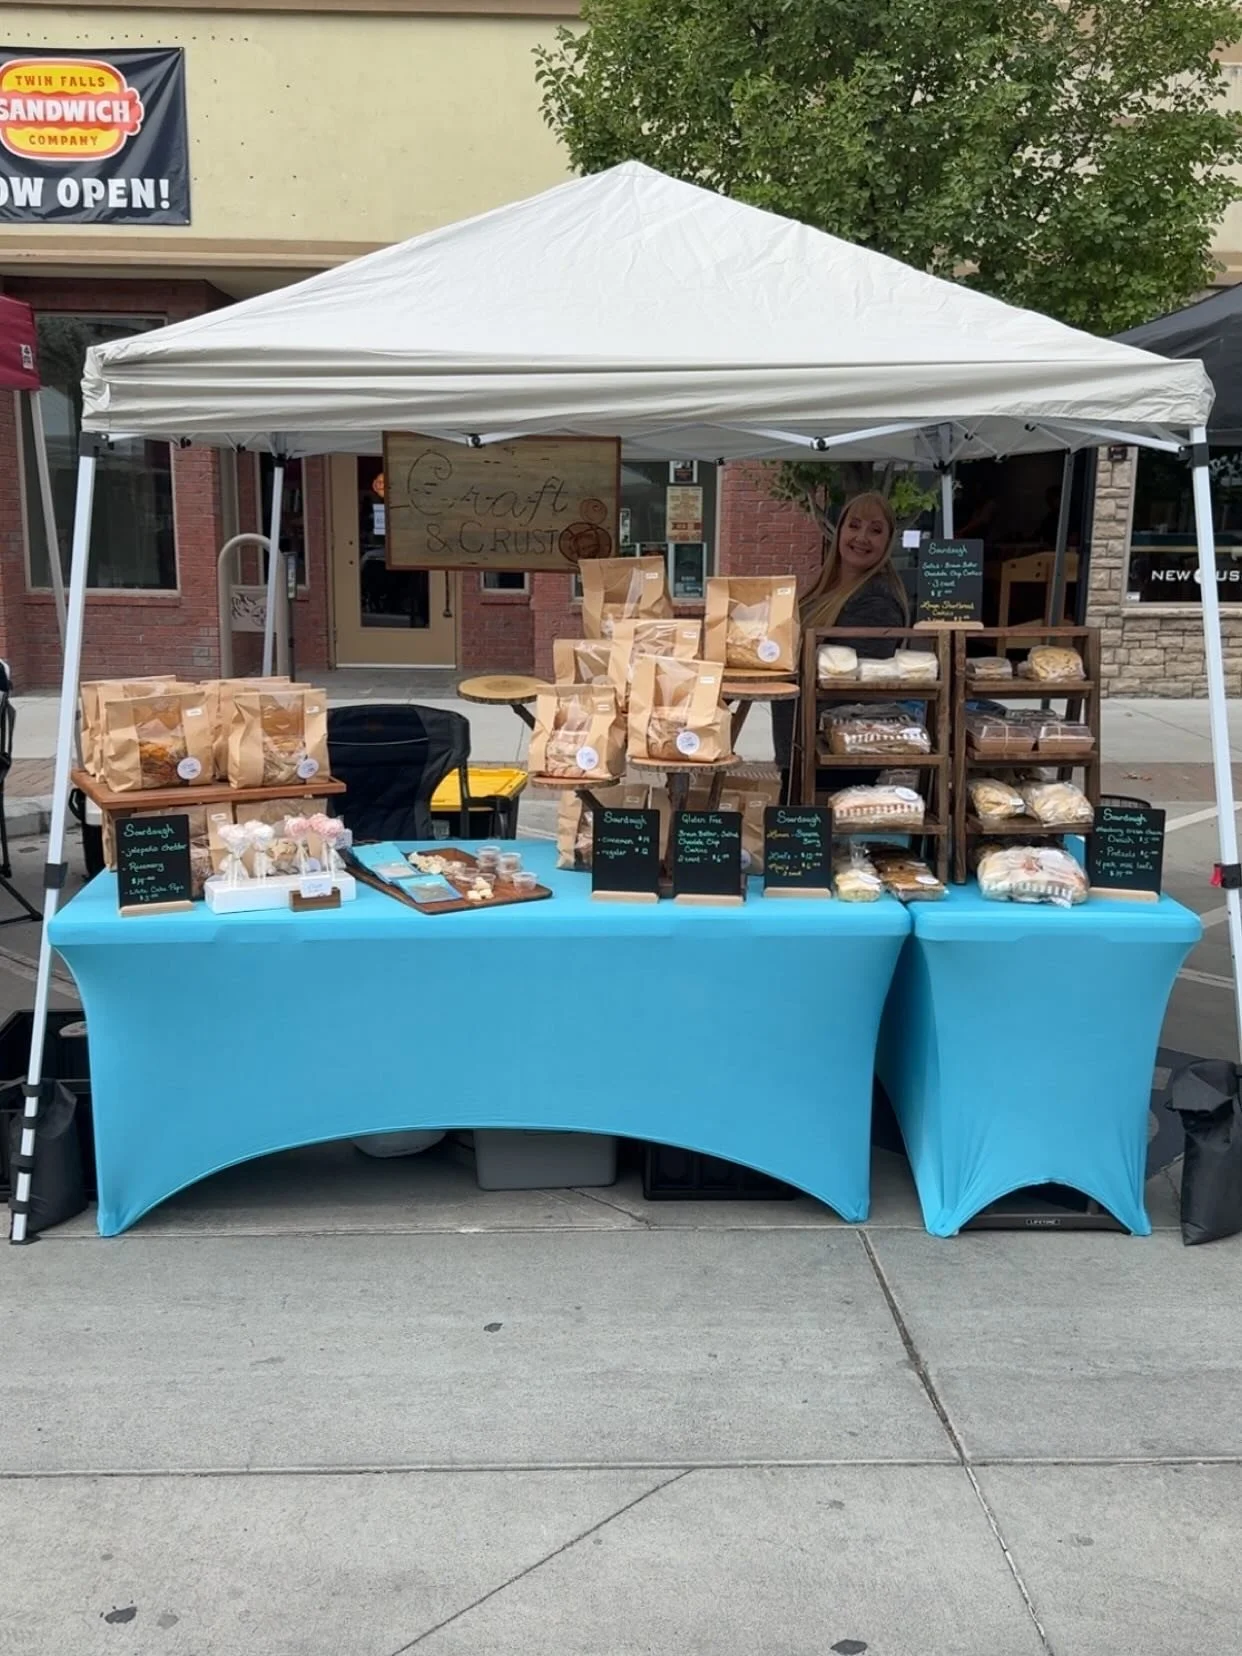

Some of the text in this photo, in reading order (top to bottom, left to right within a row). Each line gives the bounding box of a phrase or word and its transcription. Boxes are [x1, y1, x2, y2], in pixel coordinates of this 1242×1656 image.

[15, 76, 106, 87] TWIN FALLS
[0, 98, 131, 123] SANDWICH
[28, 135, 99, 146] COMPANY
[56, 177, 171, 210] OPEN!
[407, 449, 569, 526] Craft
[425, 523, 453, 554] &
[928, 542, 968, 557] Sourdough
[1151, 569, 1192, 582] NEW
[603, 811, 648, 830] Sourdough
[681, 814, 723, 825] Gluten Free
[776, 810, 822, 828] Sourdough
[1103, 808, 1148, 826] Sourdough
[123, 823, 176, 839] Sourdough
[129, 862, 165, 873] Rosemary
